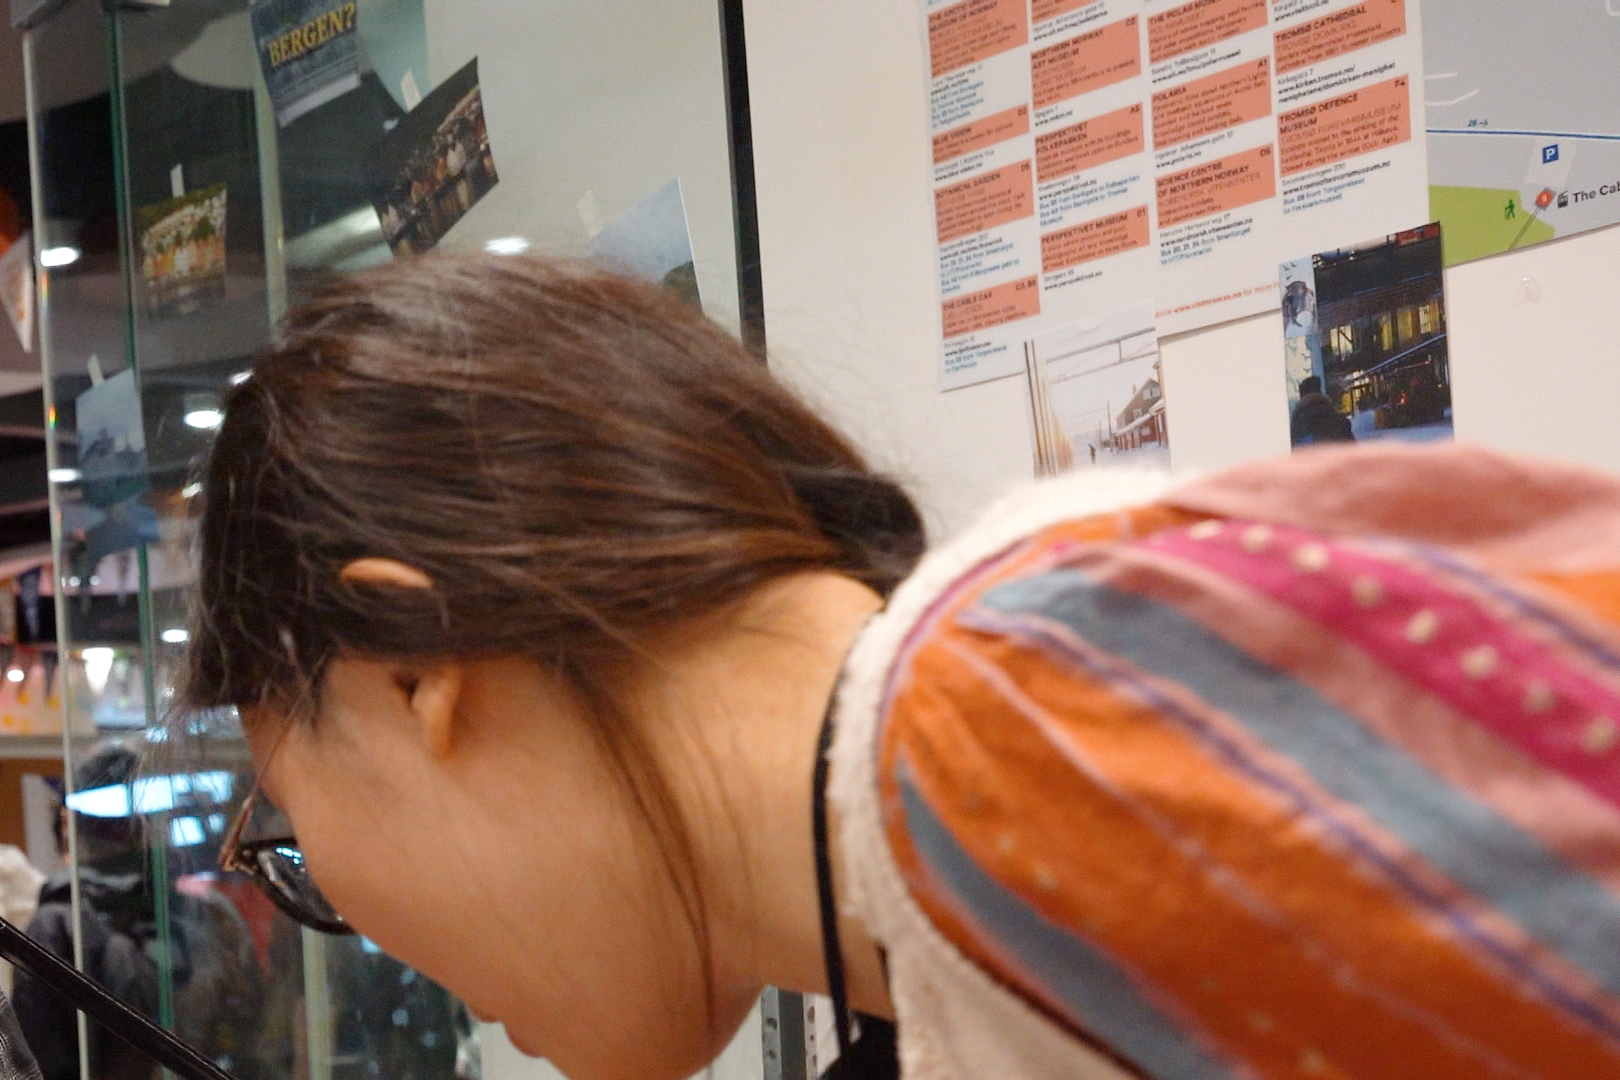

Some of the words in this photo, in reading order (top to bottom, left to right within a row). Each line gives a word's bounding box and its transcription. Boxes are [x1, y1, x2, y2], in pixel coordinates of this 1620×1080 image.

[1148, 14, 1163, 25] THE
[1166, 3, 1192, 19] POLAR
[1276, 24, 1311, 42] TROMSØ
[1314, 4, 1366, 30] CATHEDRAL
[268, 2, 357, 67] BERGEN?
[1031, 41, 1069, 60] NORTHERN
[1071, 28, 1102, 45] NORWAY
[1033, 59, 1046, 69] ART
[1048, 47, 1078, 64] MUSEUM
[1152, 85, 1186, 103] POLARIA
[1279, 106, 1315, 124] TROMSØ
[1318, 92, 1358, 112] DEFENCE
[1395, 78, 1405, 87] F4
[1036, 122, 1087, 145] PERSPEKTIVET
[1280, 116, 1316, 134] MUSEUM
[1036, 131, 1086, 154] FOLKEPARKEN
[1157, 172, 1188, 187] SCIENCE
[1191, 161, 1222, 177] CENTRE
[1157, 189, 1166, 198] OF
[1170, 175, 1212, 194] NORTHERN
[1214, 164, 1248, 180] NORWAY
[1284, 197, 1294, 205] Bus
[1306, 189, 1321, 198] from
[1572, 188, 1596, 203] The
[1042, 223, 1093, 244] PERSPEKTIVET
[1095, 213, 1127, 228] MUSEUM
[978, 291, 992, 300] CAR
